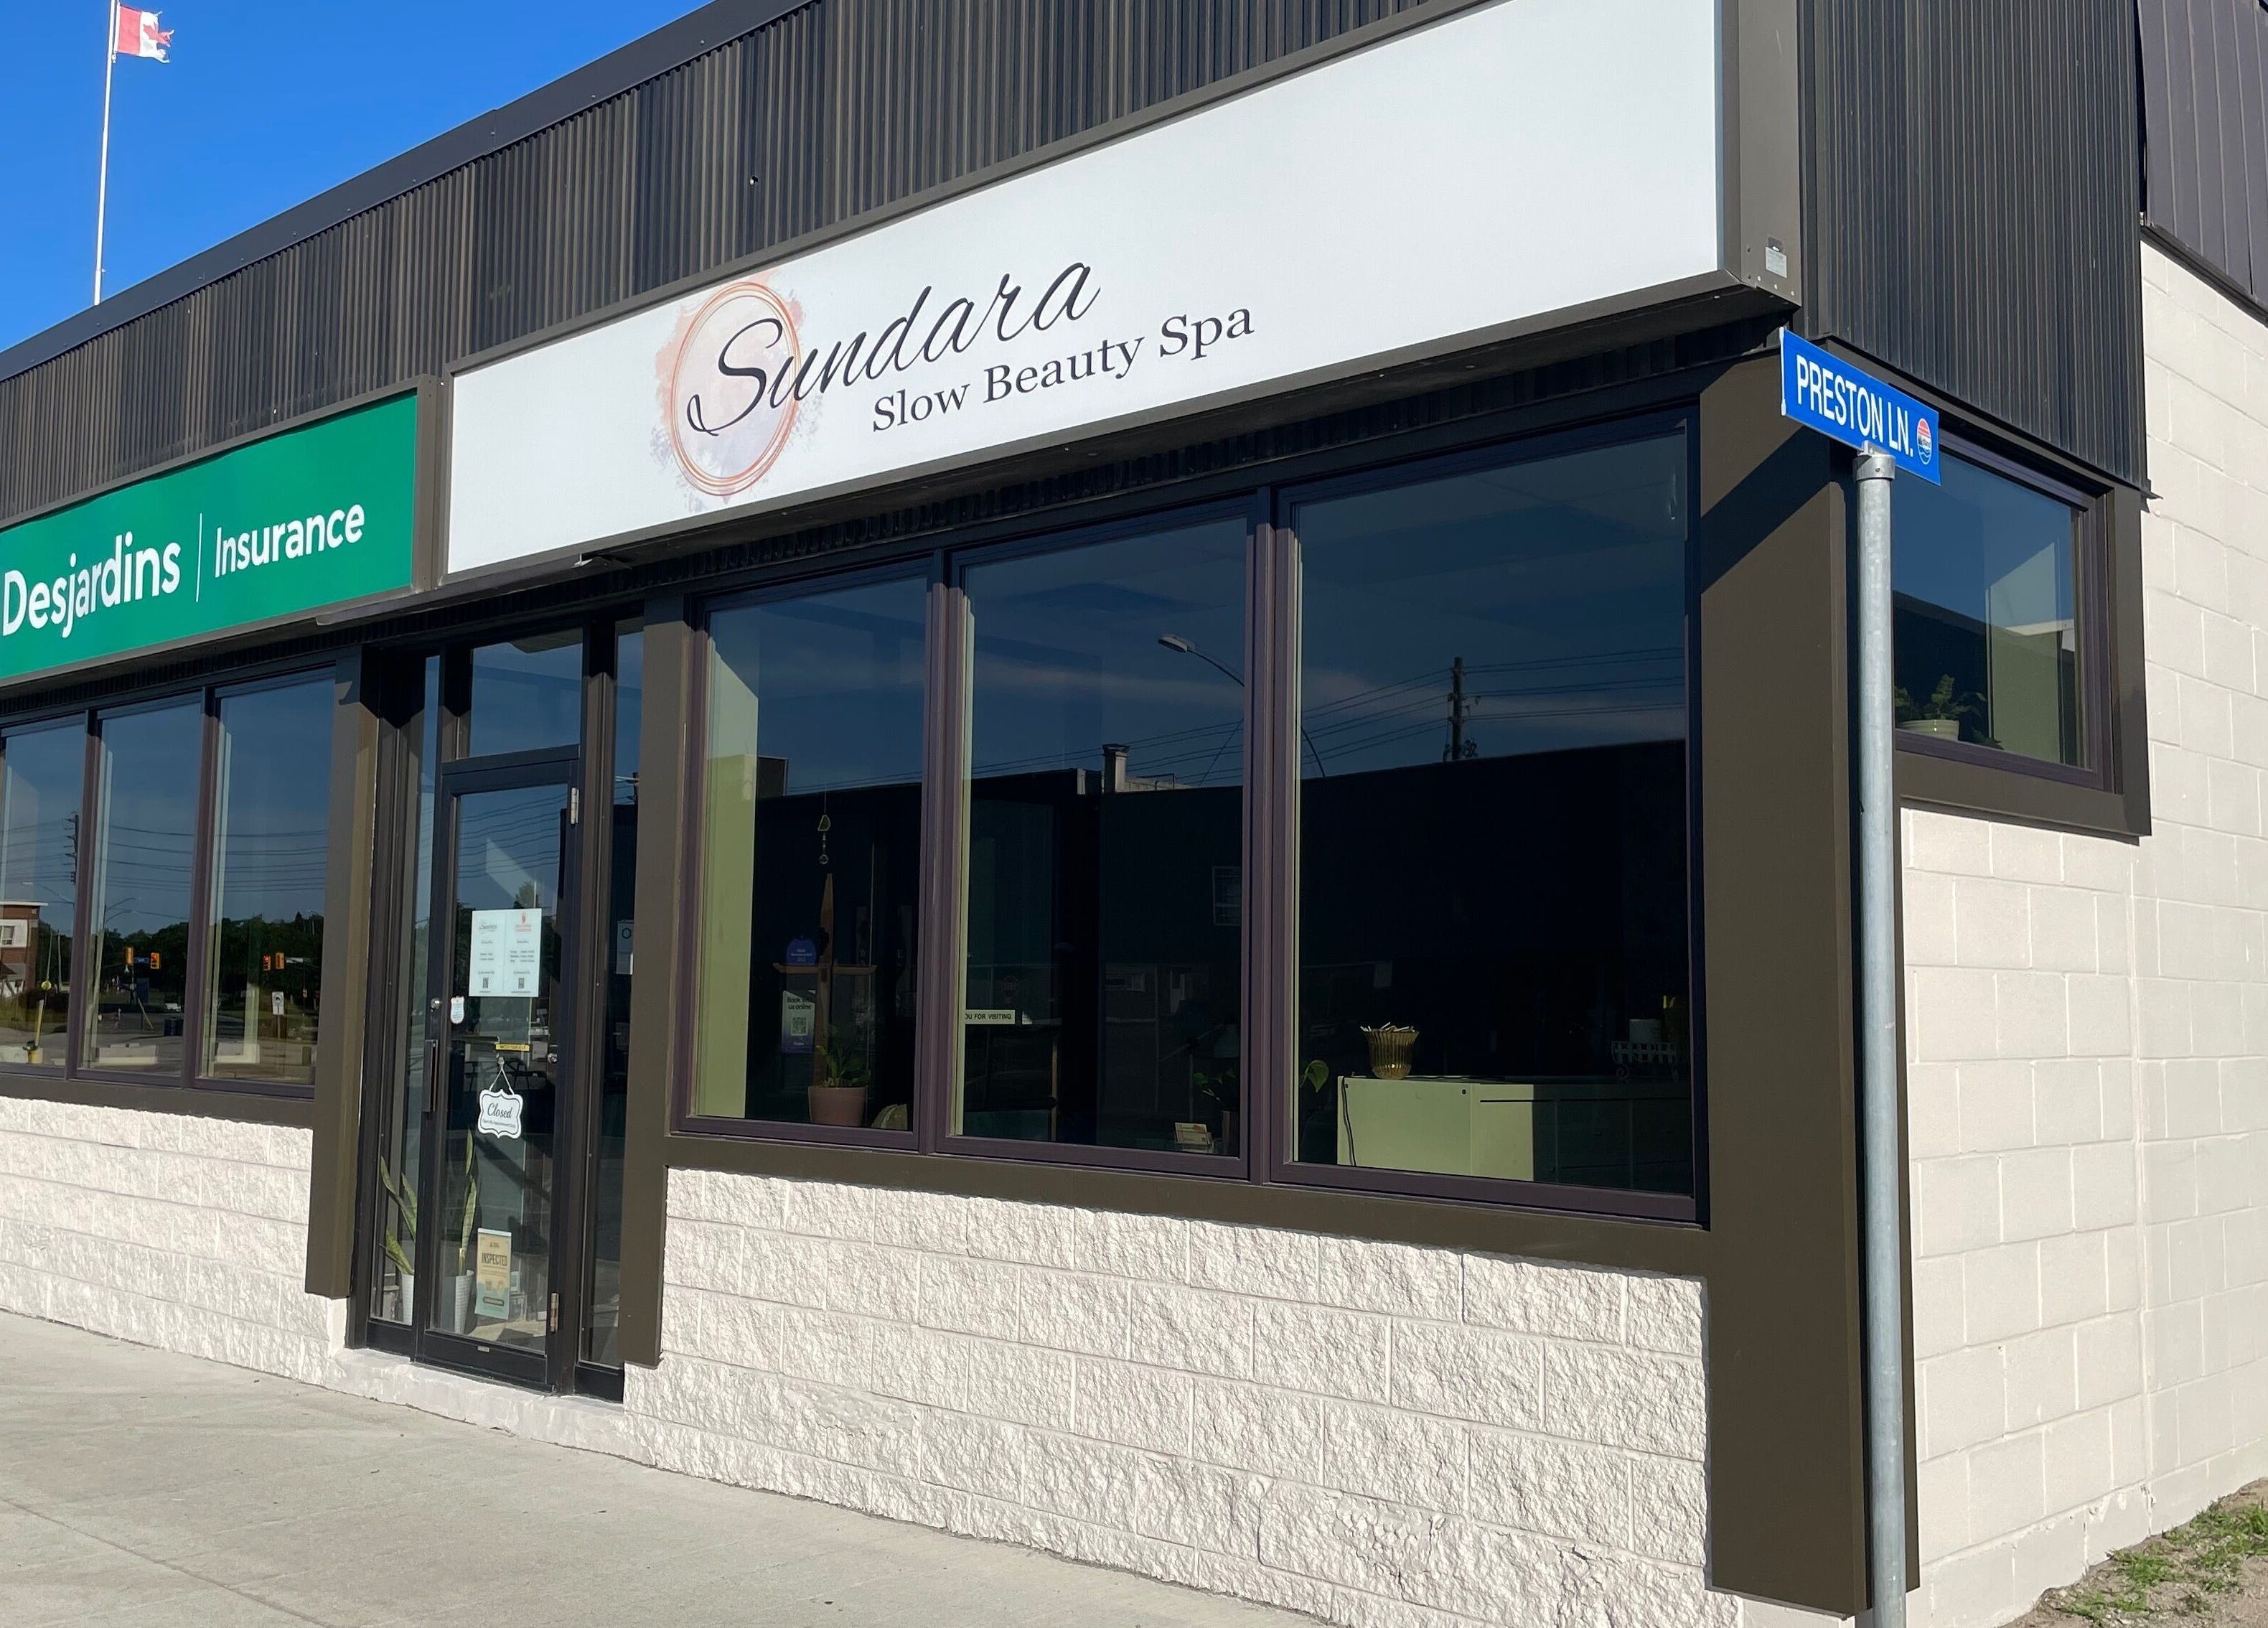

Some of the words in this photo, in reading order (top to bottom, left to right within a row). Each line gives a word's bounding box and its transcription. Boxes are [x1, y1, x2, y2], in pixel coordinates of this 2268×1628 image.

[686, 261, 1102, 437] Sundara
[872, 383, 970, 431] Slow
[983, 334, 1145, 403] Beauty
[1158, 307, 1255, 360] Spa
[1796, 354, 1883, 444] PRESTON
[1888, 401, 1914, 458] LN.
[1, 530, 182, 638] Desjardins
[215, 504, 365, 579] Insurance
[487, 1103, 513, 1118] Closed
[482, 1252, 508, 1266] INSPECTED
